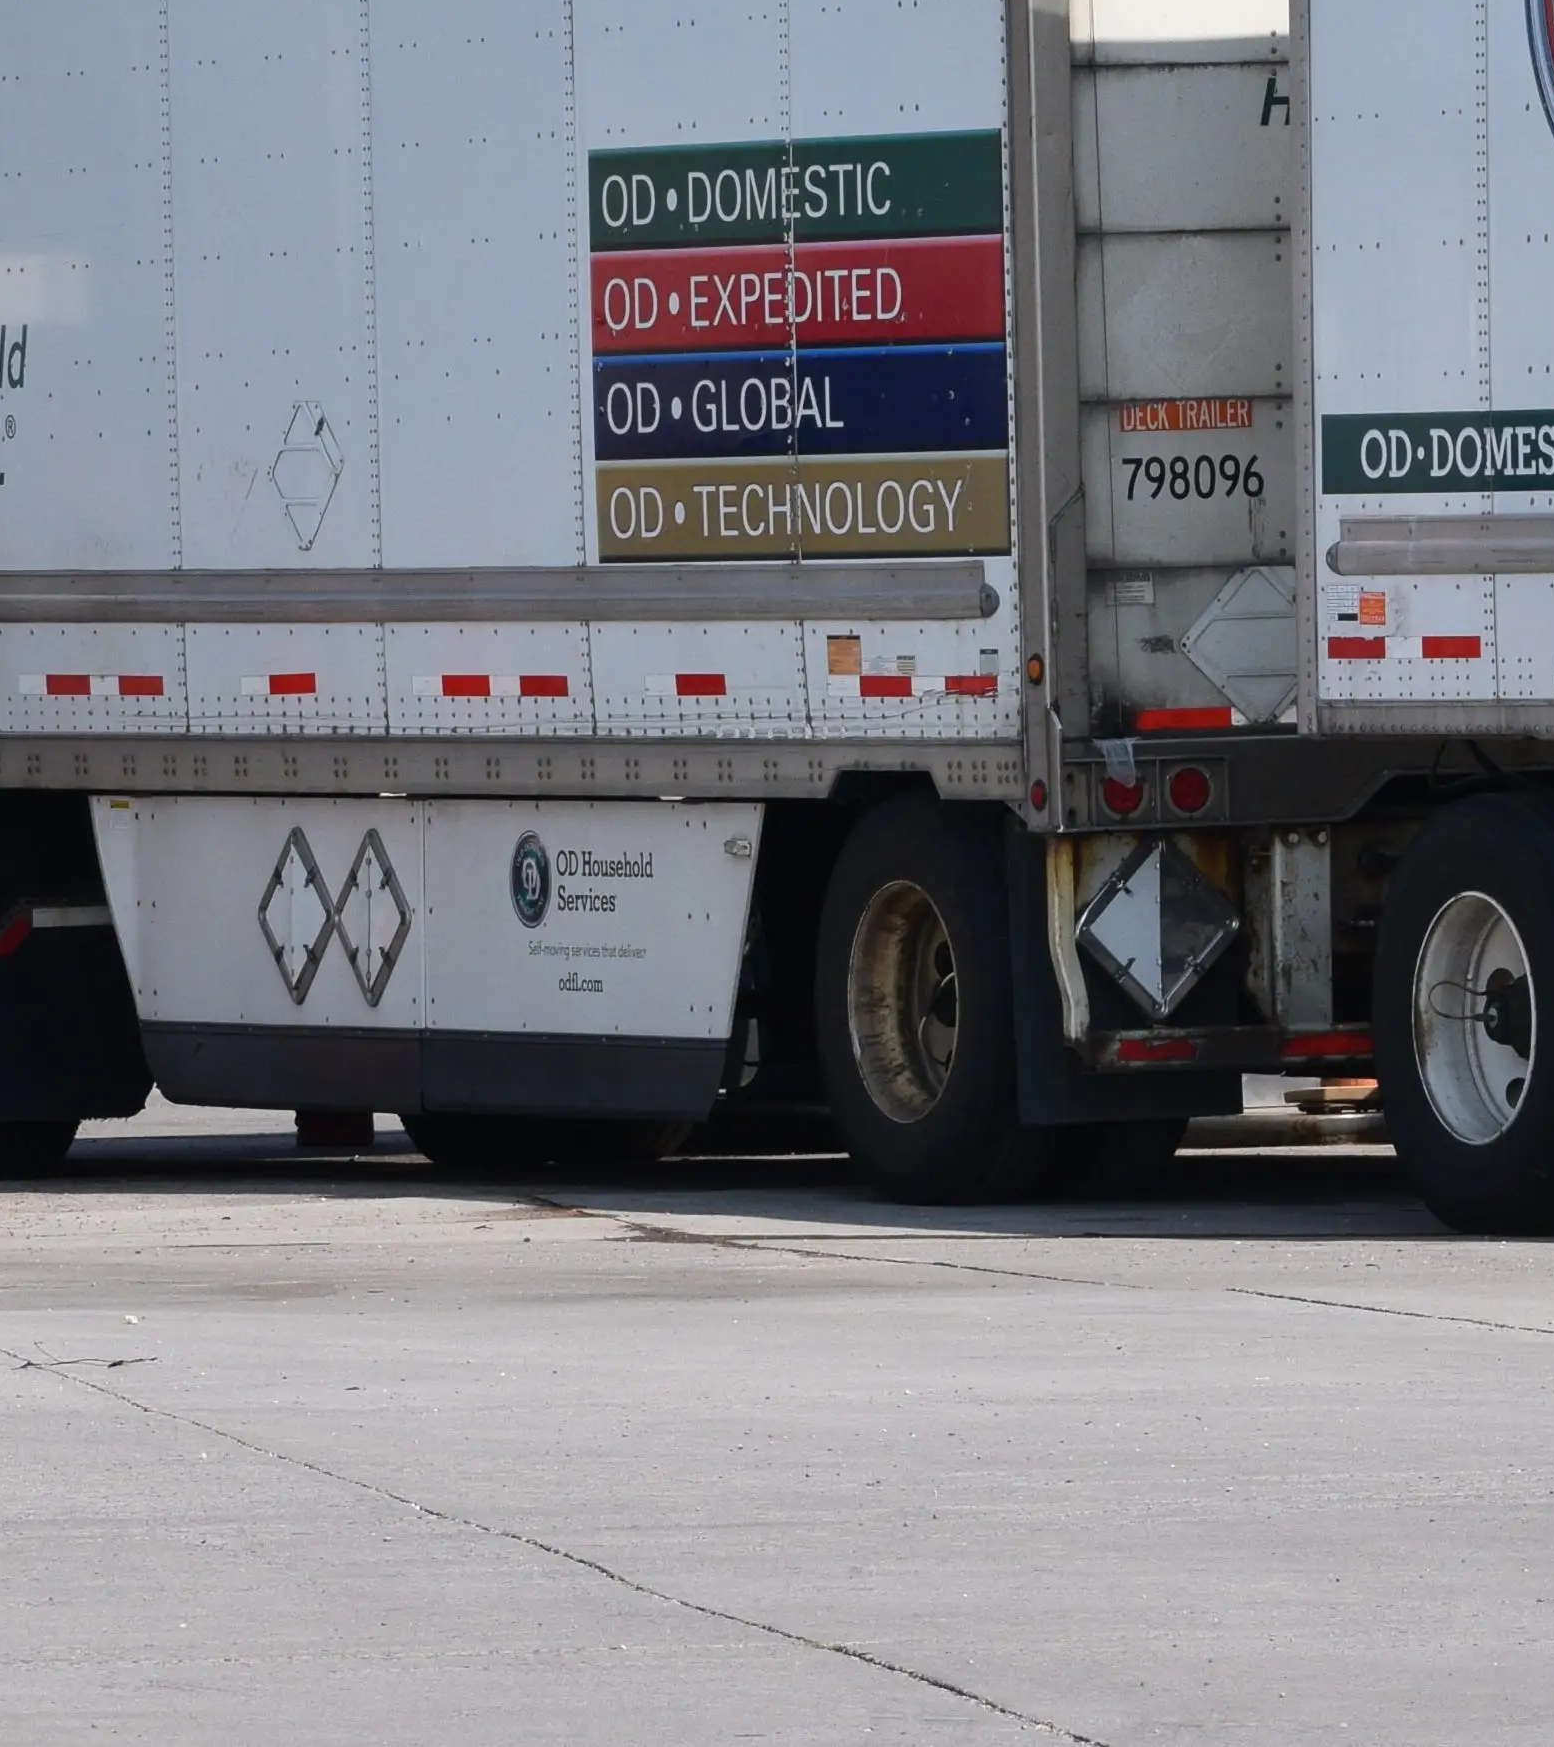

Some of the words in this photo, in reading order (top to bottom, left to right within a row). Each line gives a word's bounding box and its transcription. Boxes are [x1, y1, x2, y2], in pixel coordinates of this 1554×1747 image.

[1122, 402, 1169, 432] DECK
[1175, 399, 1249, 430] TRAILER
[1121, 454, 1265, 501] 798096
[556, 850, 579, 877] OD
[581, 850, 654, 879] Household
[557, 885, 617, 913] Services
[528, 940, 570, 960] Self-moving
[571, 943, 601, 958] services
[601, 943, 618, 959] that
[558, 972, 604, 993] odfl.com
